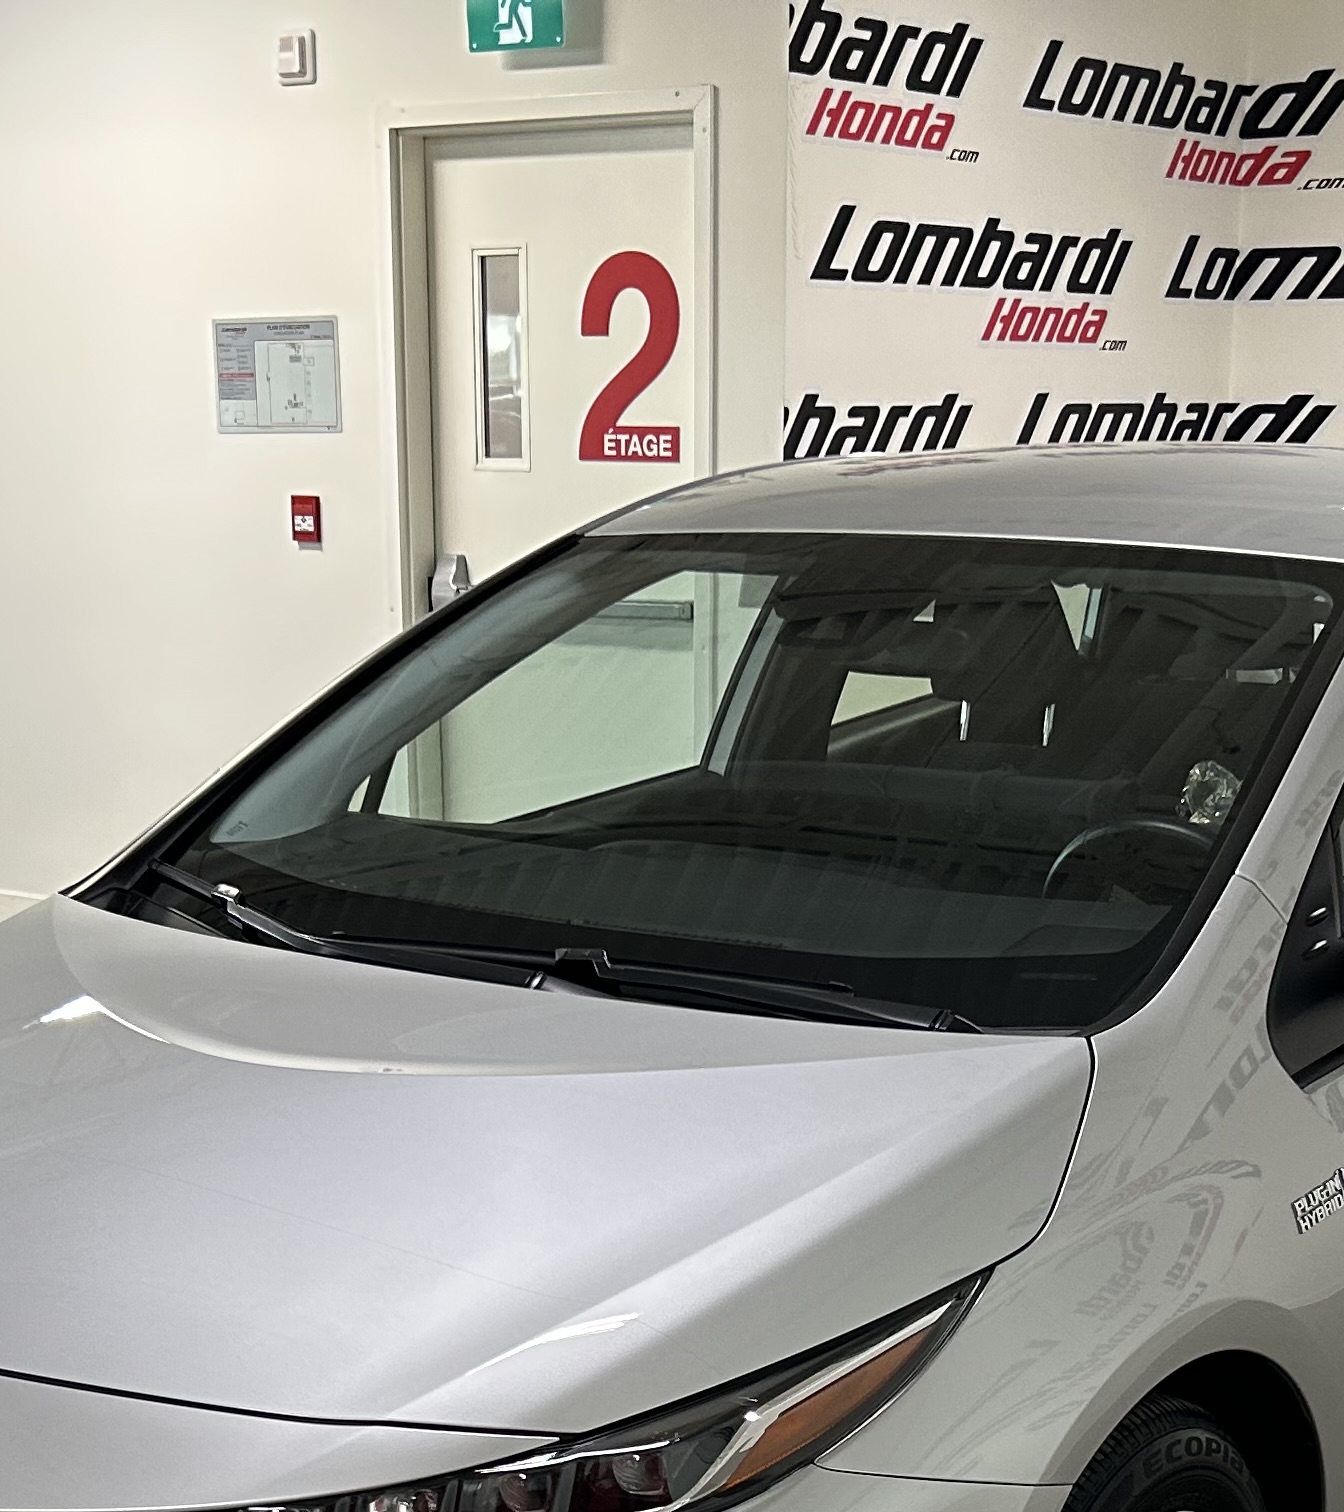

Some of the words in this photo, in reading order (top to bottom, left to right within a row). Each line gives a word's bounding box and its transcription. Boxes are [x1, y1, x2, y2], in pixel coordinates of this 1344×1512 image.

[789, 0, 984, 98] bardi
[806, 88, 955, 151] Honda
[1166, 138, 1311, 187] Honda
[810, 205, 1133, 296] Lombardi
[981, 297, 1108, 345] Honda
[603, 428, 672, 457] ÉTAGE
[784, 393, 973, 458] bardi
[1299, 1193, 1344, 1233] HYBRID
